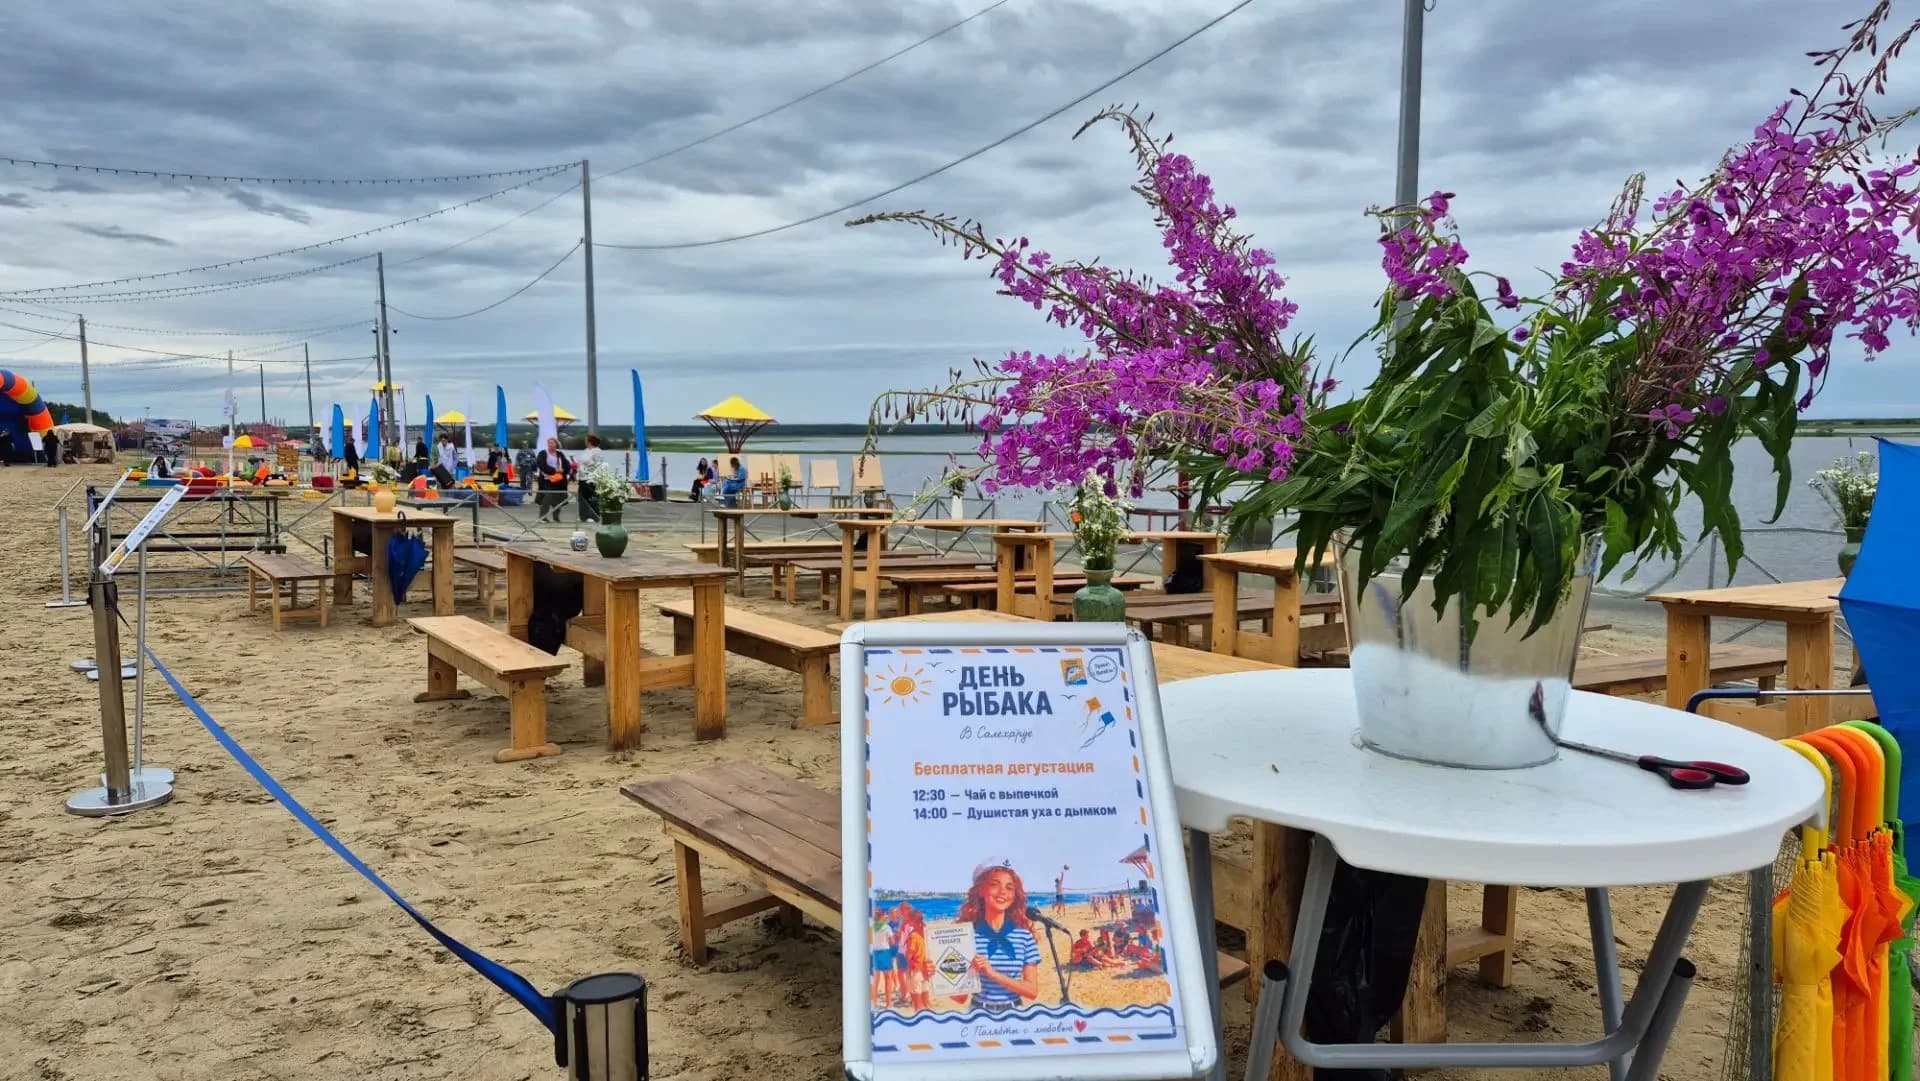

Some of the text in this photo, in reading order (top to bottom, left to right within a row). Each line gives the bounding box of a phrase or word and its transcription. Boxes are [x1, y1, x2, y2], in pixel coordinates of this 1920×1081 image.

[959, 666, 1025, 690] ДЕНЬ
[943, 691, 1053, 716] РЫБАКА
[960, 725, 1033, 743] В Салехарде
[914, 761, 1095, 777] Бесплатная дегустация
[913, 789, 946, 801] 12:30
[964, 788, 987, 801] Чай
[989, 790, 997, 800] с
[999, 787, 1059, 800] выпечкой
[913, 807, 948, 820] 14:00
[967, 806, 1029, 820] Душистая
[1031, 808, 1053, 820] уха
[1055, 808, 1062, 817] с
[1064, 805, 1118, 818] дымком
